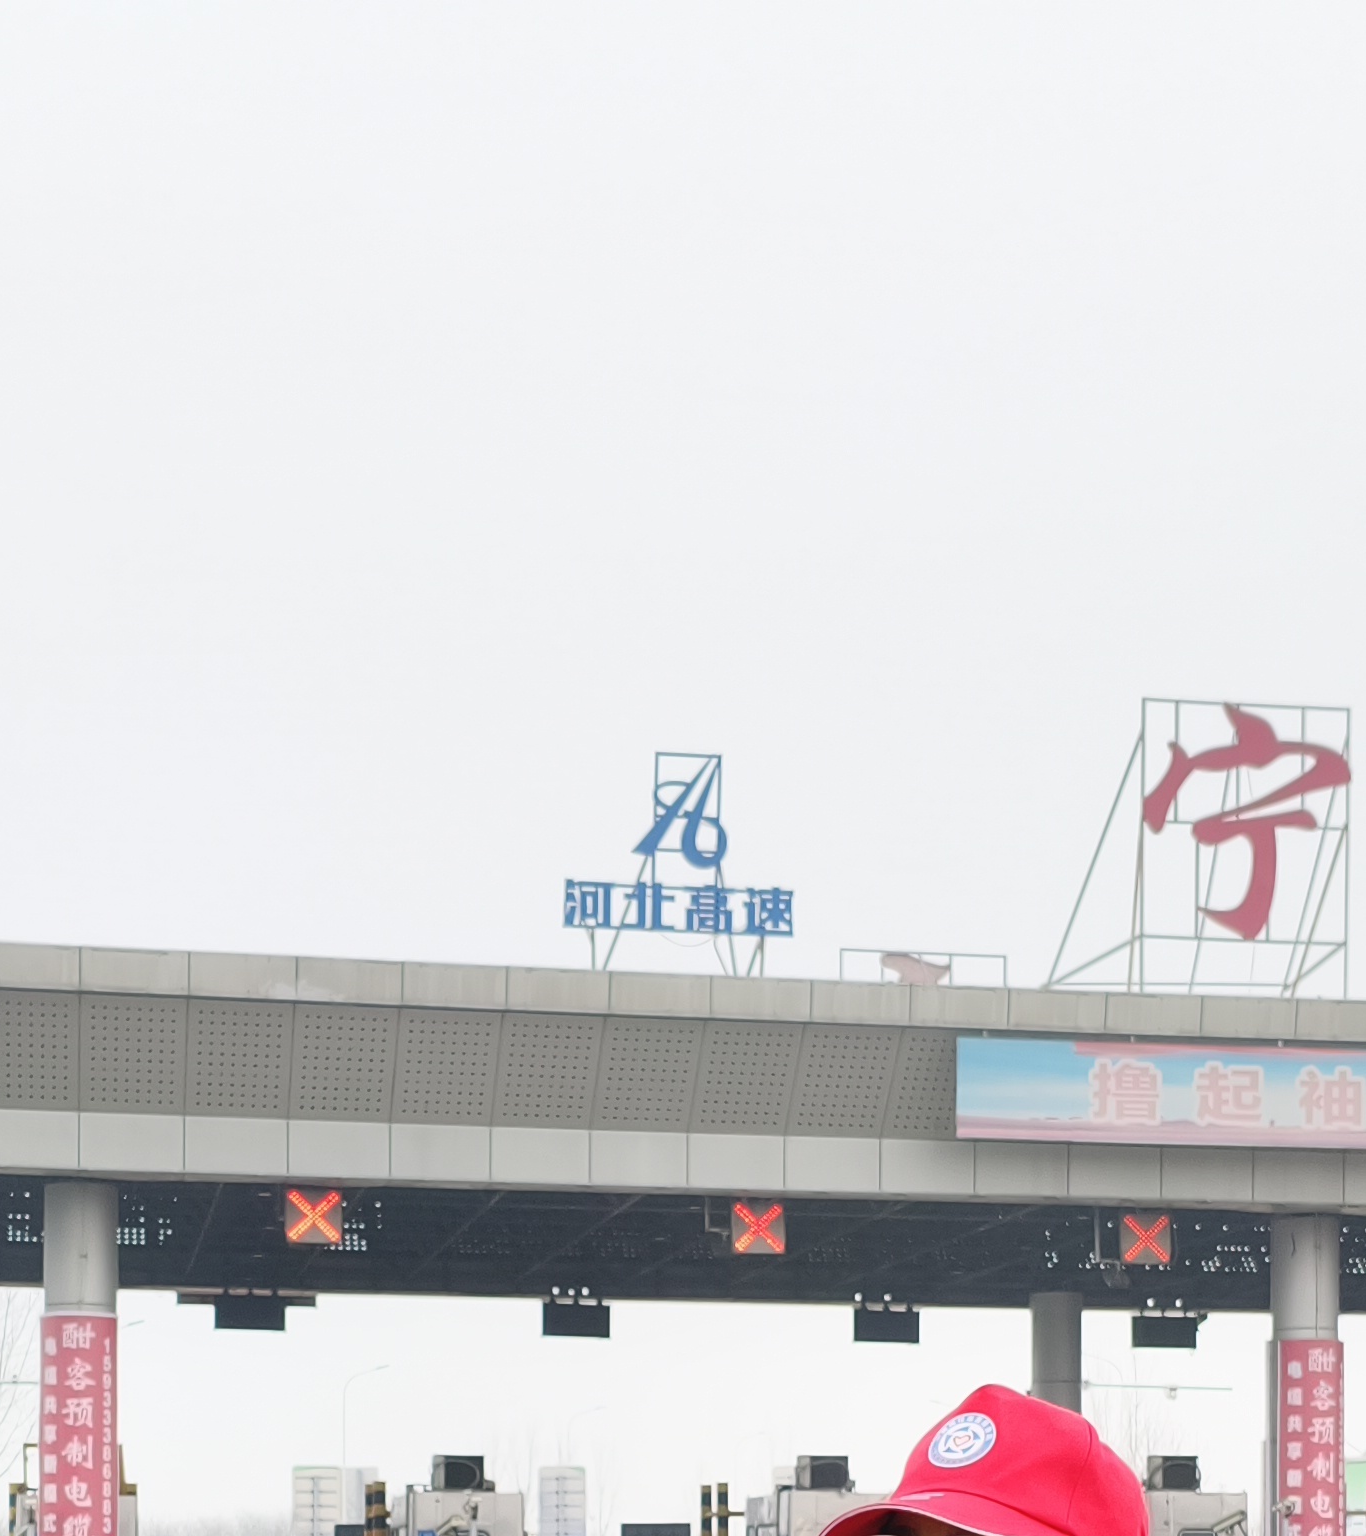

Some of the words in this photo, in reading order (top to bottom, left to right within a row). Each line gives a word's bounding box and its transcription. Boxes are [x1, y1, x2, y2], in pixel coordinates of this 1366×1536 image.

[1141, 702, 1352, 940] 宁
[563, 879, 794, 938] 河北高速
